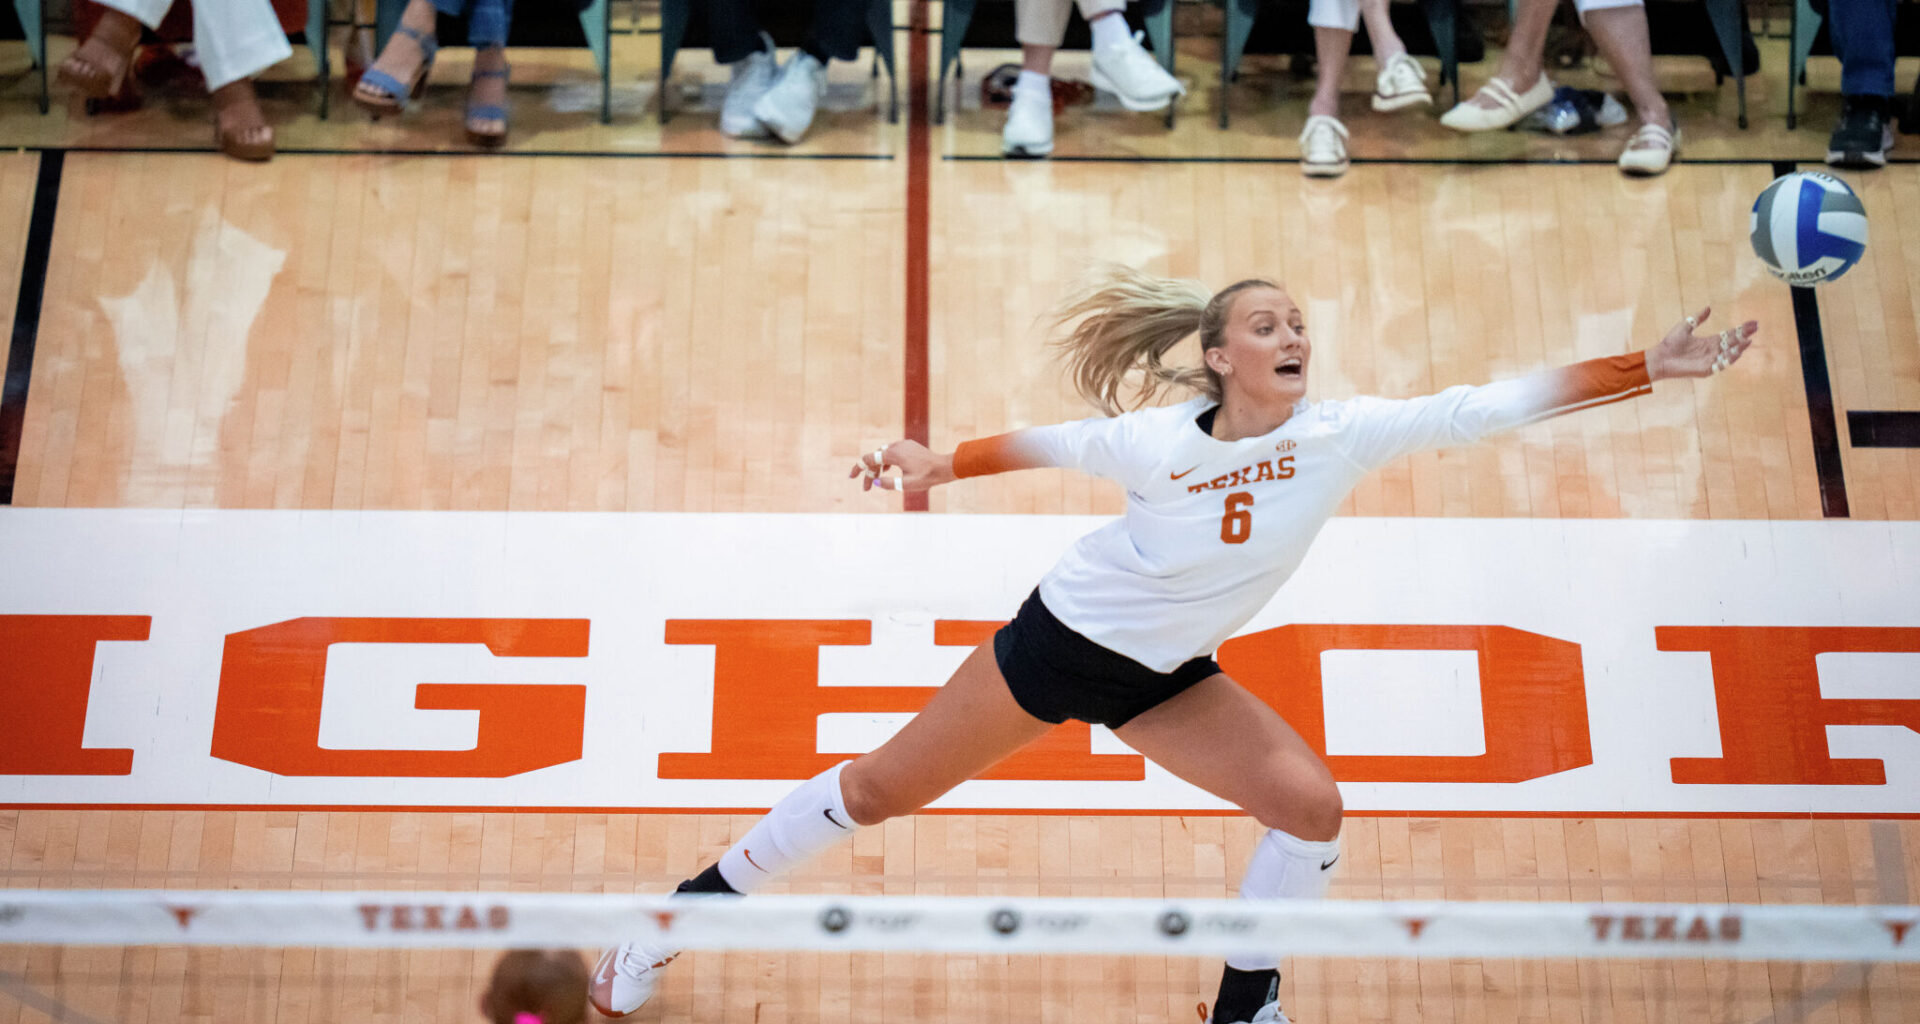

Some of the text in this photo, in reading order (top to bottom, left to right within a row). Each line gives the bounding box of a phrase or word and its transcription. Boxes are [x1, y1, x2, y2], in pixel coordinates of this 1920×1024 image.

[1220, 491, 1254, 544] 6
[357, 904, 511, 932] TEXAS
[1588, 914, 1743, 943] TEXAS
